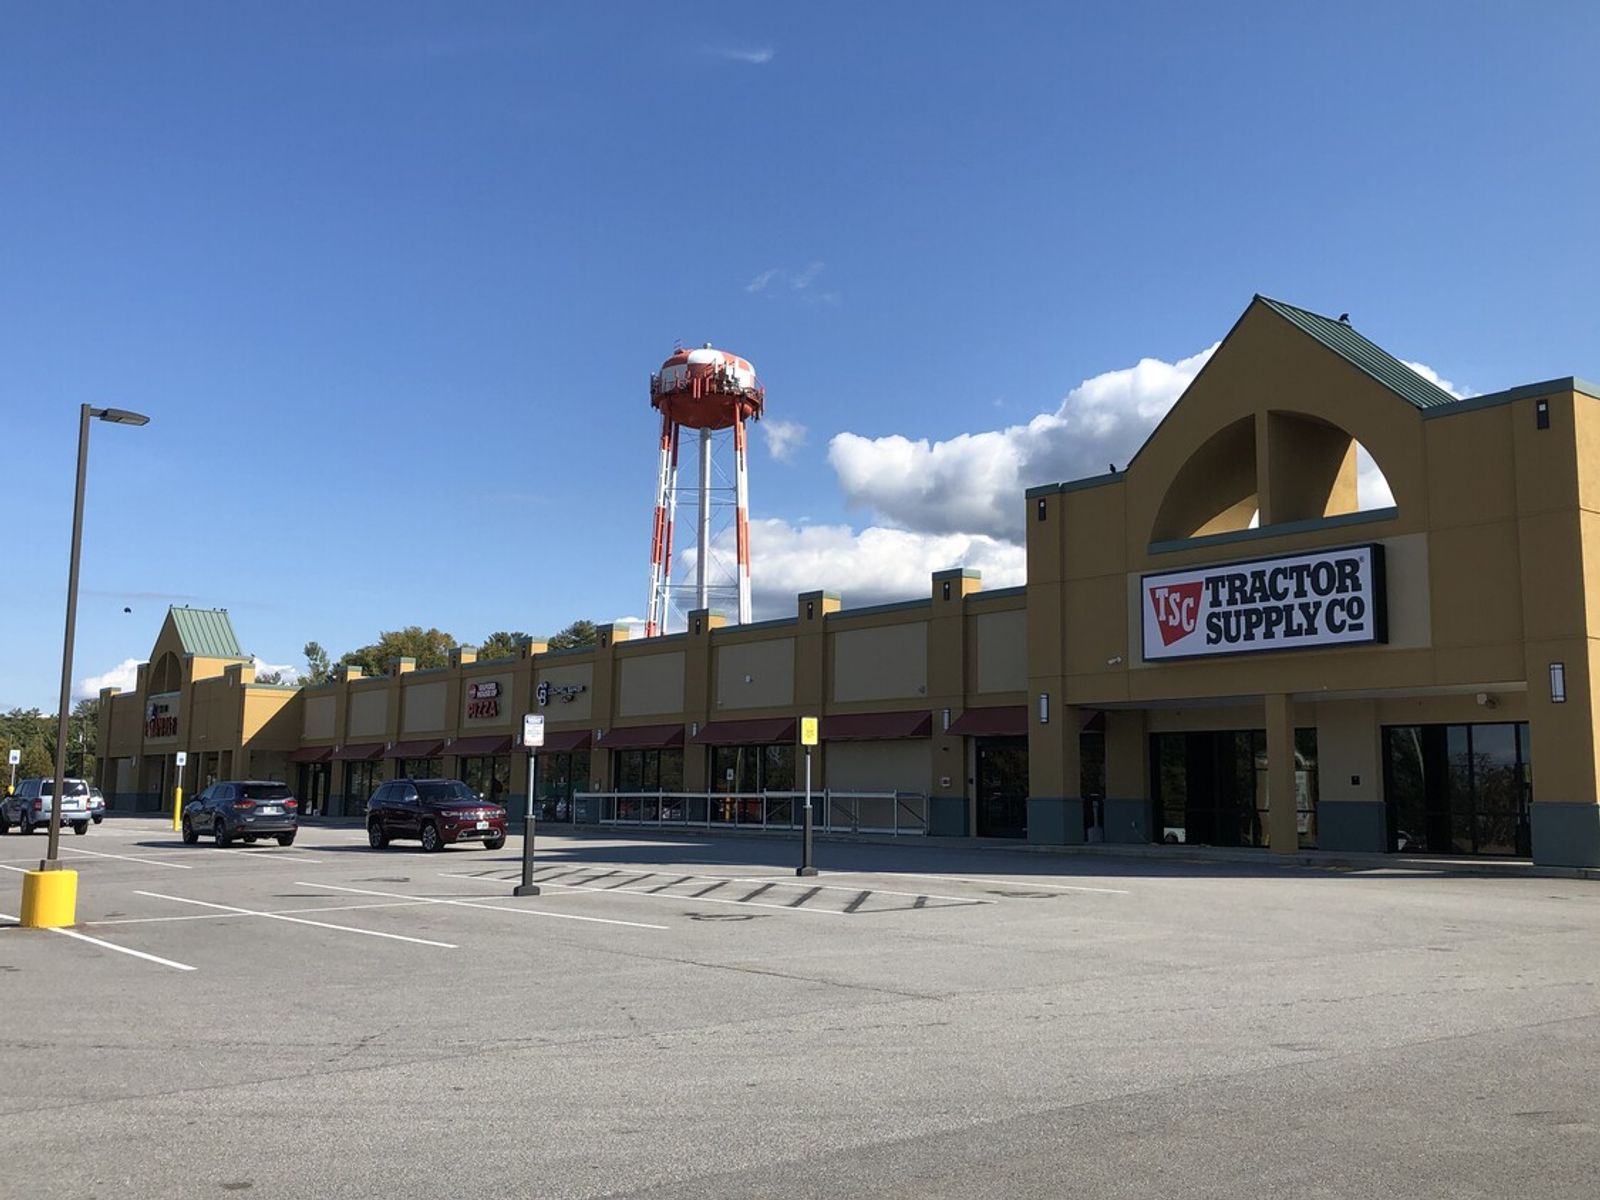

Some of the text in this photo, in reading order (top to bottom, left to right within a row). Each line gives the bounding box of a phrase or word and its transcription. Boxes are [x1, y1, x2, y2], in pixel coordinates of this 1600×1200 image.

[1204, 558, 1362, 608] TRACTOR
[1154, 587, 1195, 633] TSC
[1205, 601, 1322, 646] SUPPLY
[466, 700, 498, 719] PIZZA
